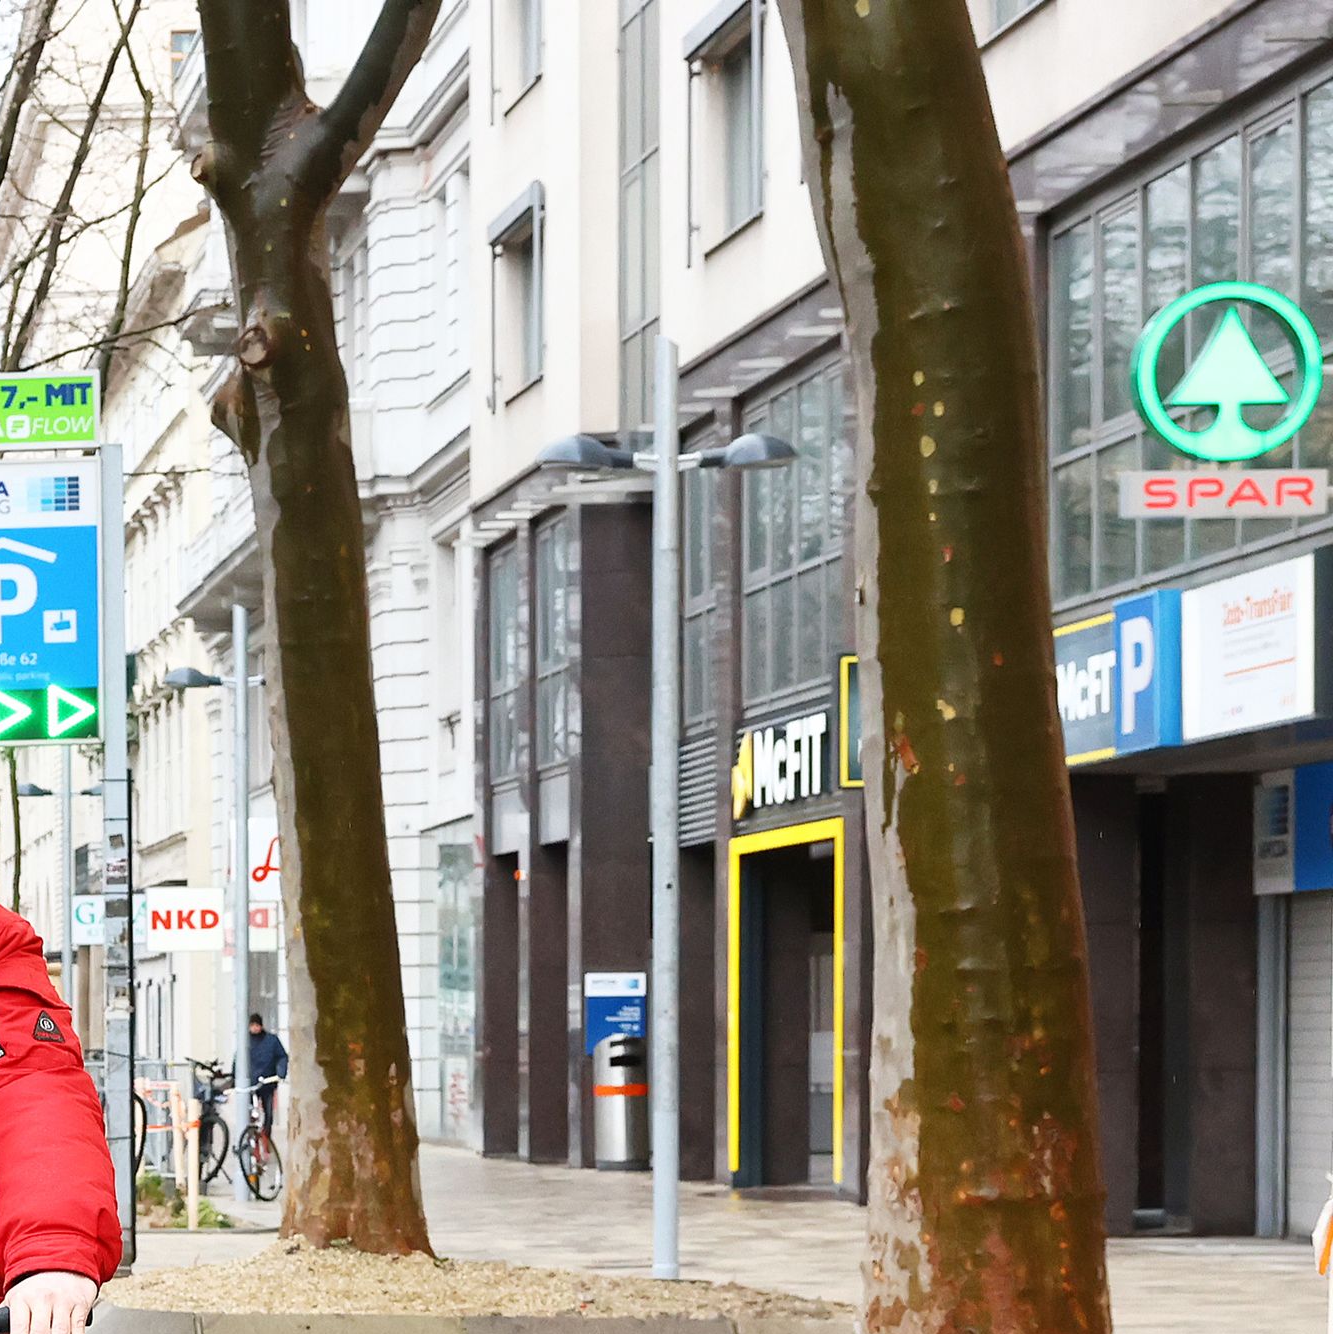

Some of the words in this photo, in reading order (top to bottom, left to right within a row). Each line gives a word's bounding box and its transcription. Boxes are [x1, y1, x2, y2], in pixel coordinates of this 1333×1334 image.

[45, 382, 92, 407] MIT
[33, 416, 94, 435] FLOW
[1144, 477, 1315, 508] SPAR
[19, 653, 38, 665] 62
[1120, 617, 1155, 735] P
[752, 712, 828, 809] McFIT
[151, 910, 220, 930] NKD
